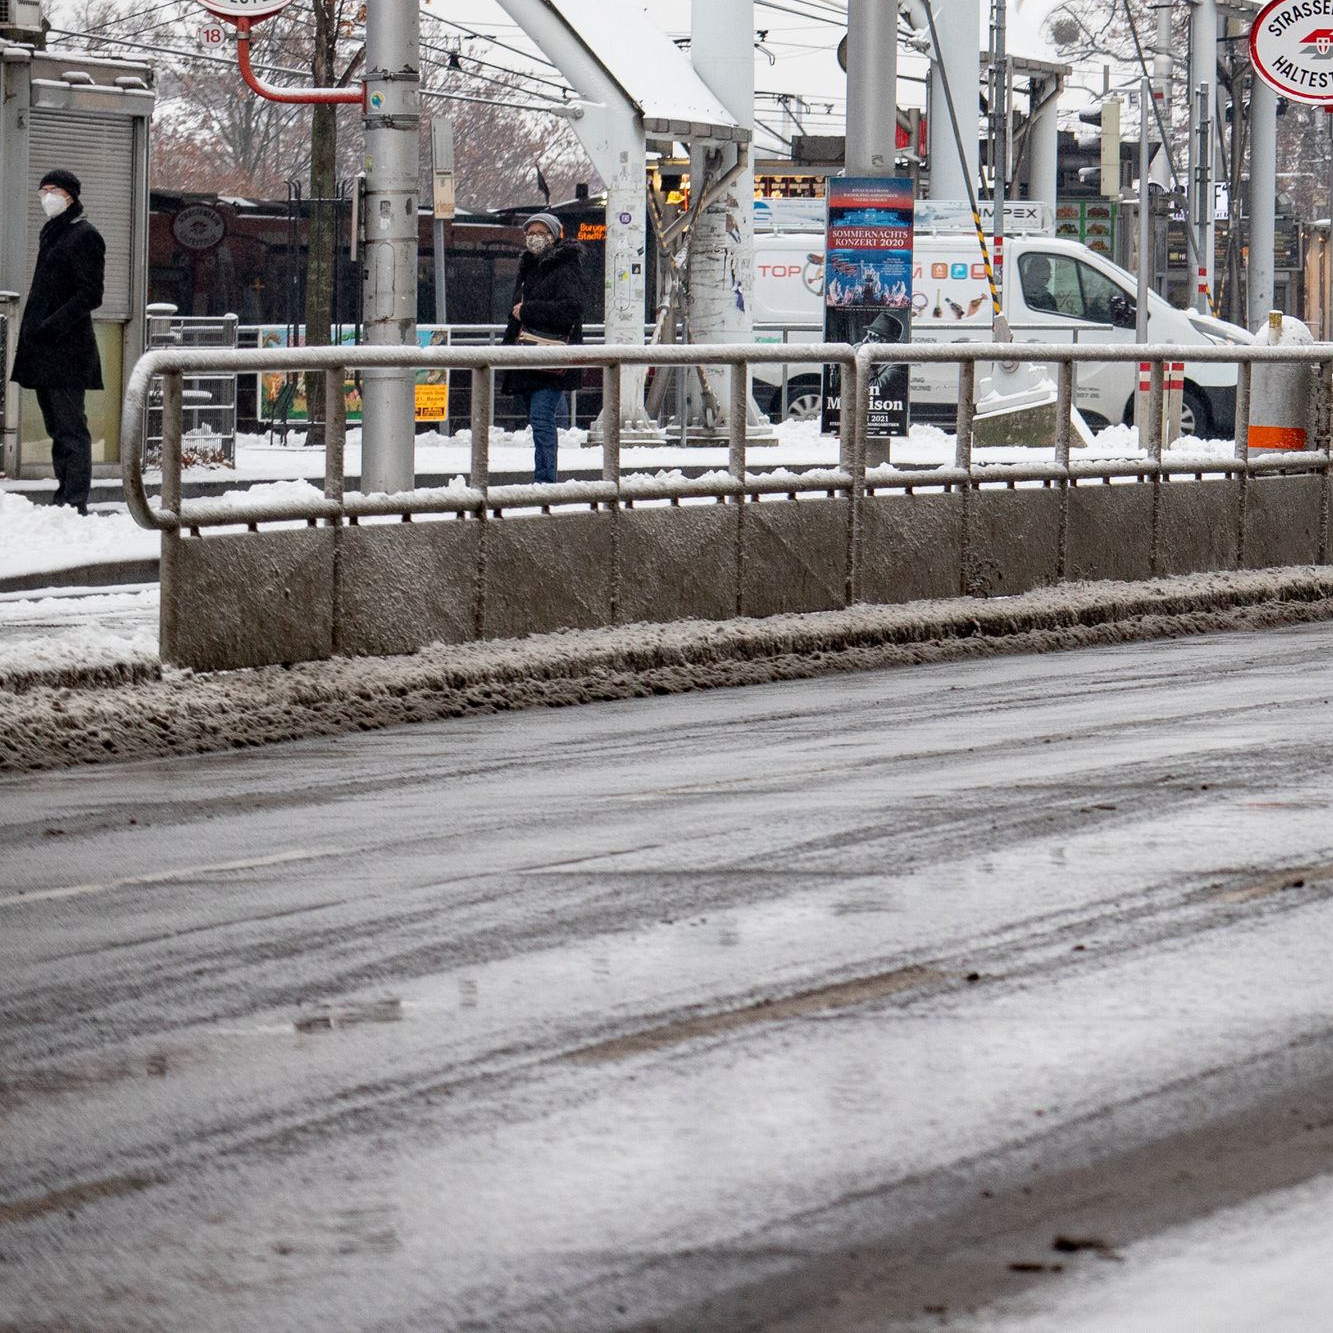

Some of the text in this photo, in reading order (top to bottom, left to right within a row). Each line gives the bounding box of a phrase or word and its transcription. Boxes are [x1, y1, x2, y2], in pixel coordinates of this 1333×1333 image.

[203, 29, 221, 43] 18
[832, 230, 908, 239] SOMMERNACHTS
[835, 238, 905, 247] KONZERT 2020
[757, 265, 802, 278] TOP
[826, 396, 904, 411] Mison
